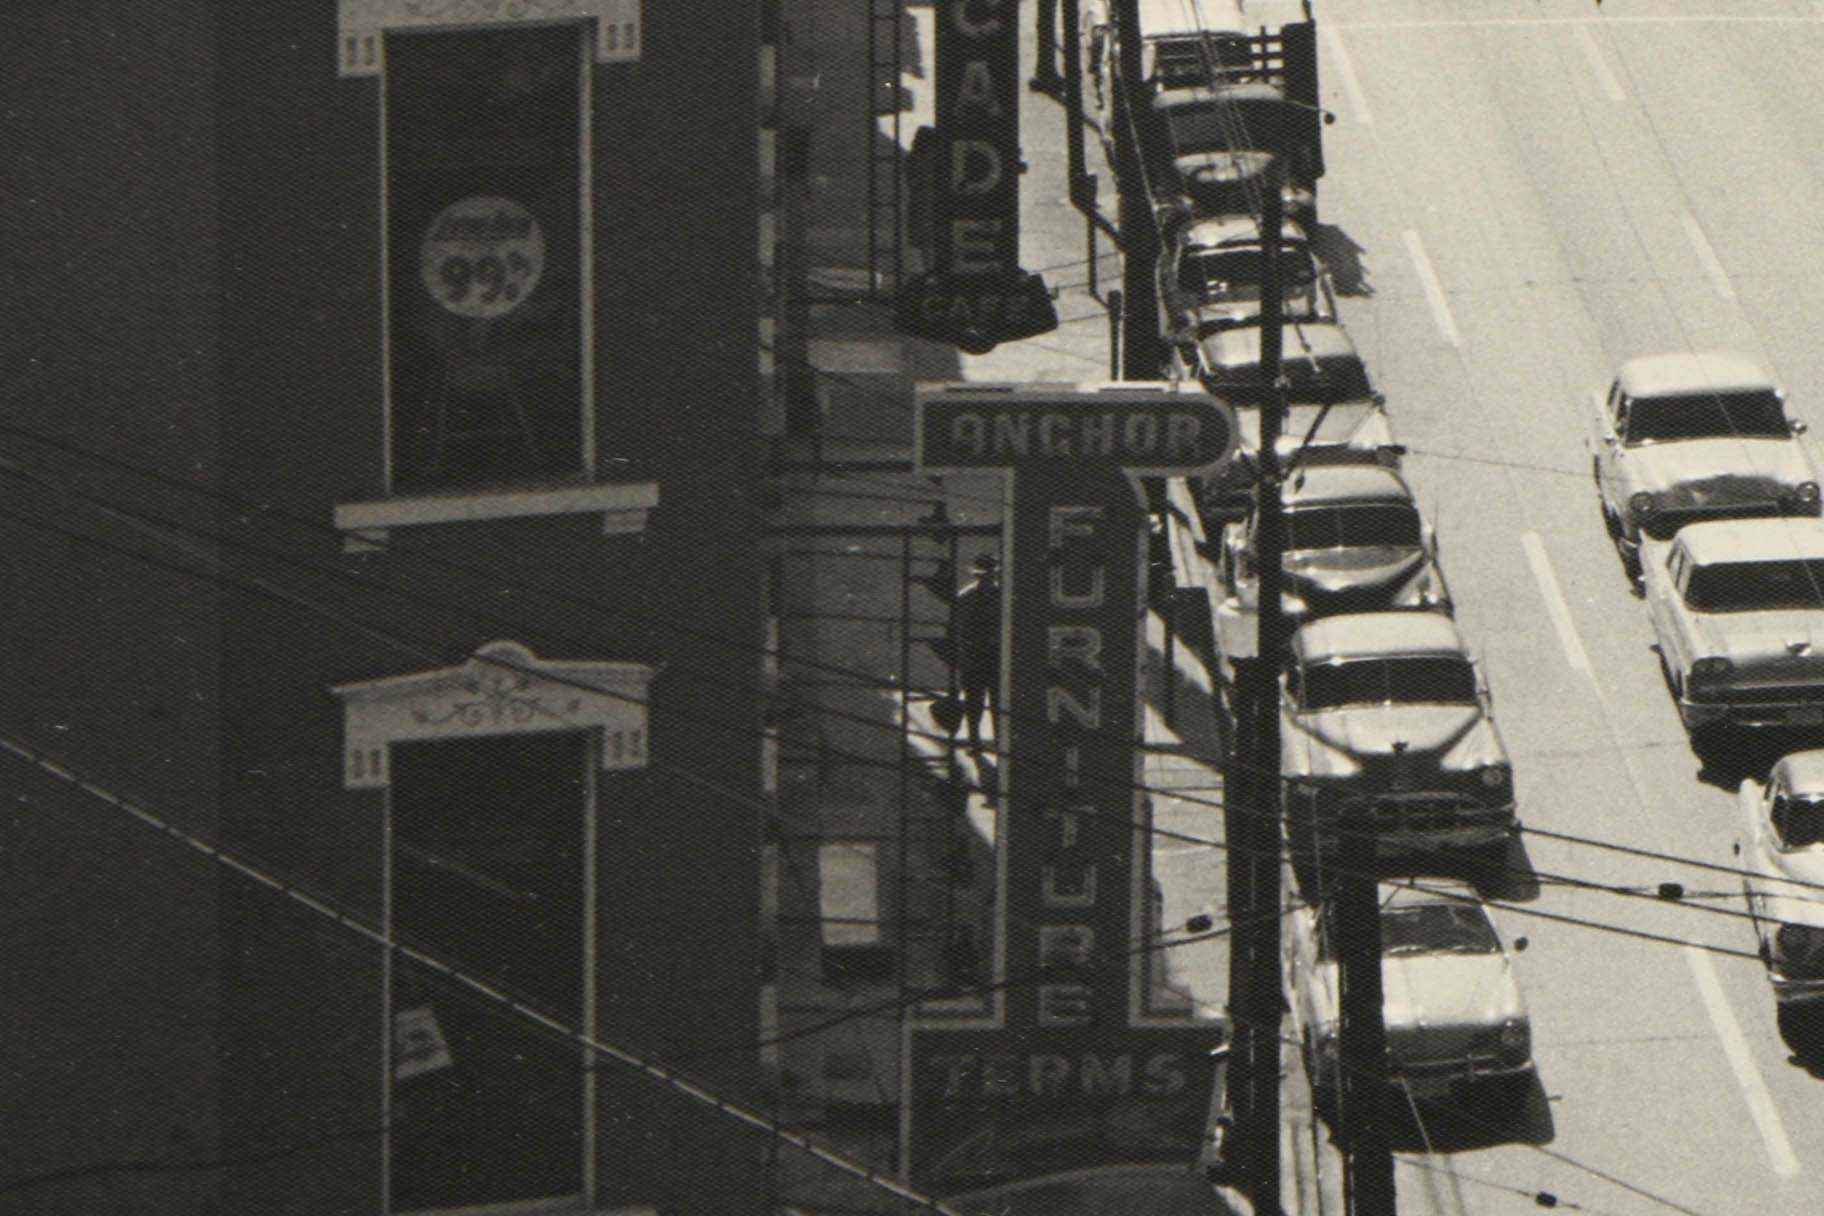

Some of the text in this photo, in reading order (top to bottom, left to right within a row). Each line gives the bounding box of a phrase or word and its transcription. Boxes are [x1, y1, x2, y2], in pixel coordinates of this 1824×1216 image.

[951, 411, 1202, 457] ANCHOR
[1039, 505, 1104, 1026] FURNITURE
[928, 1052, 1186, 1096] TERMS
